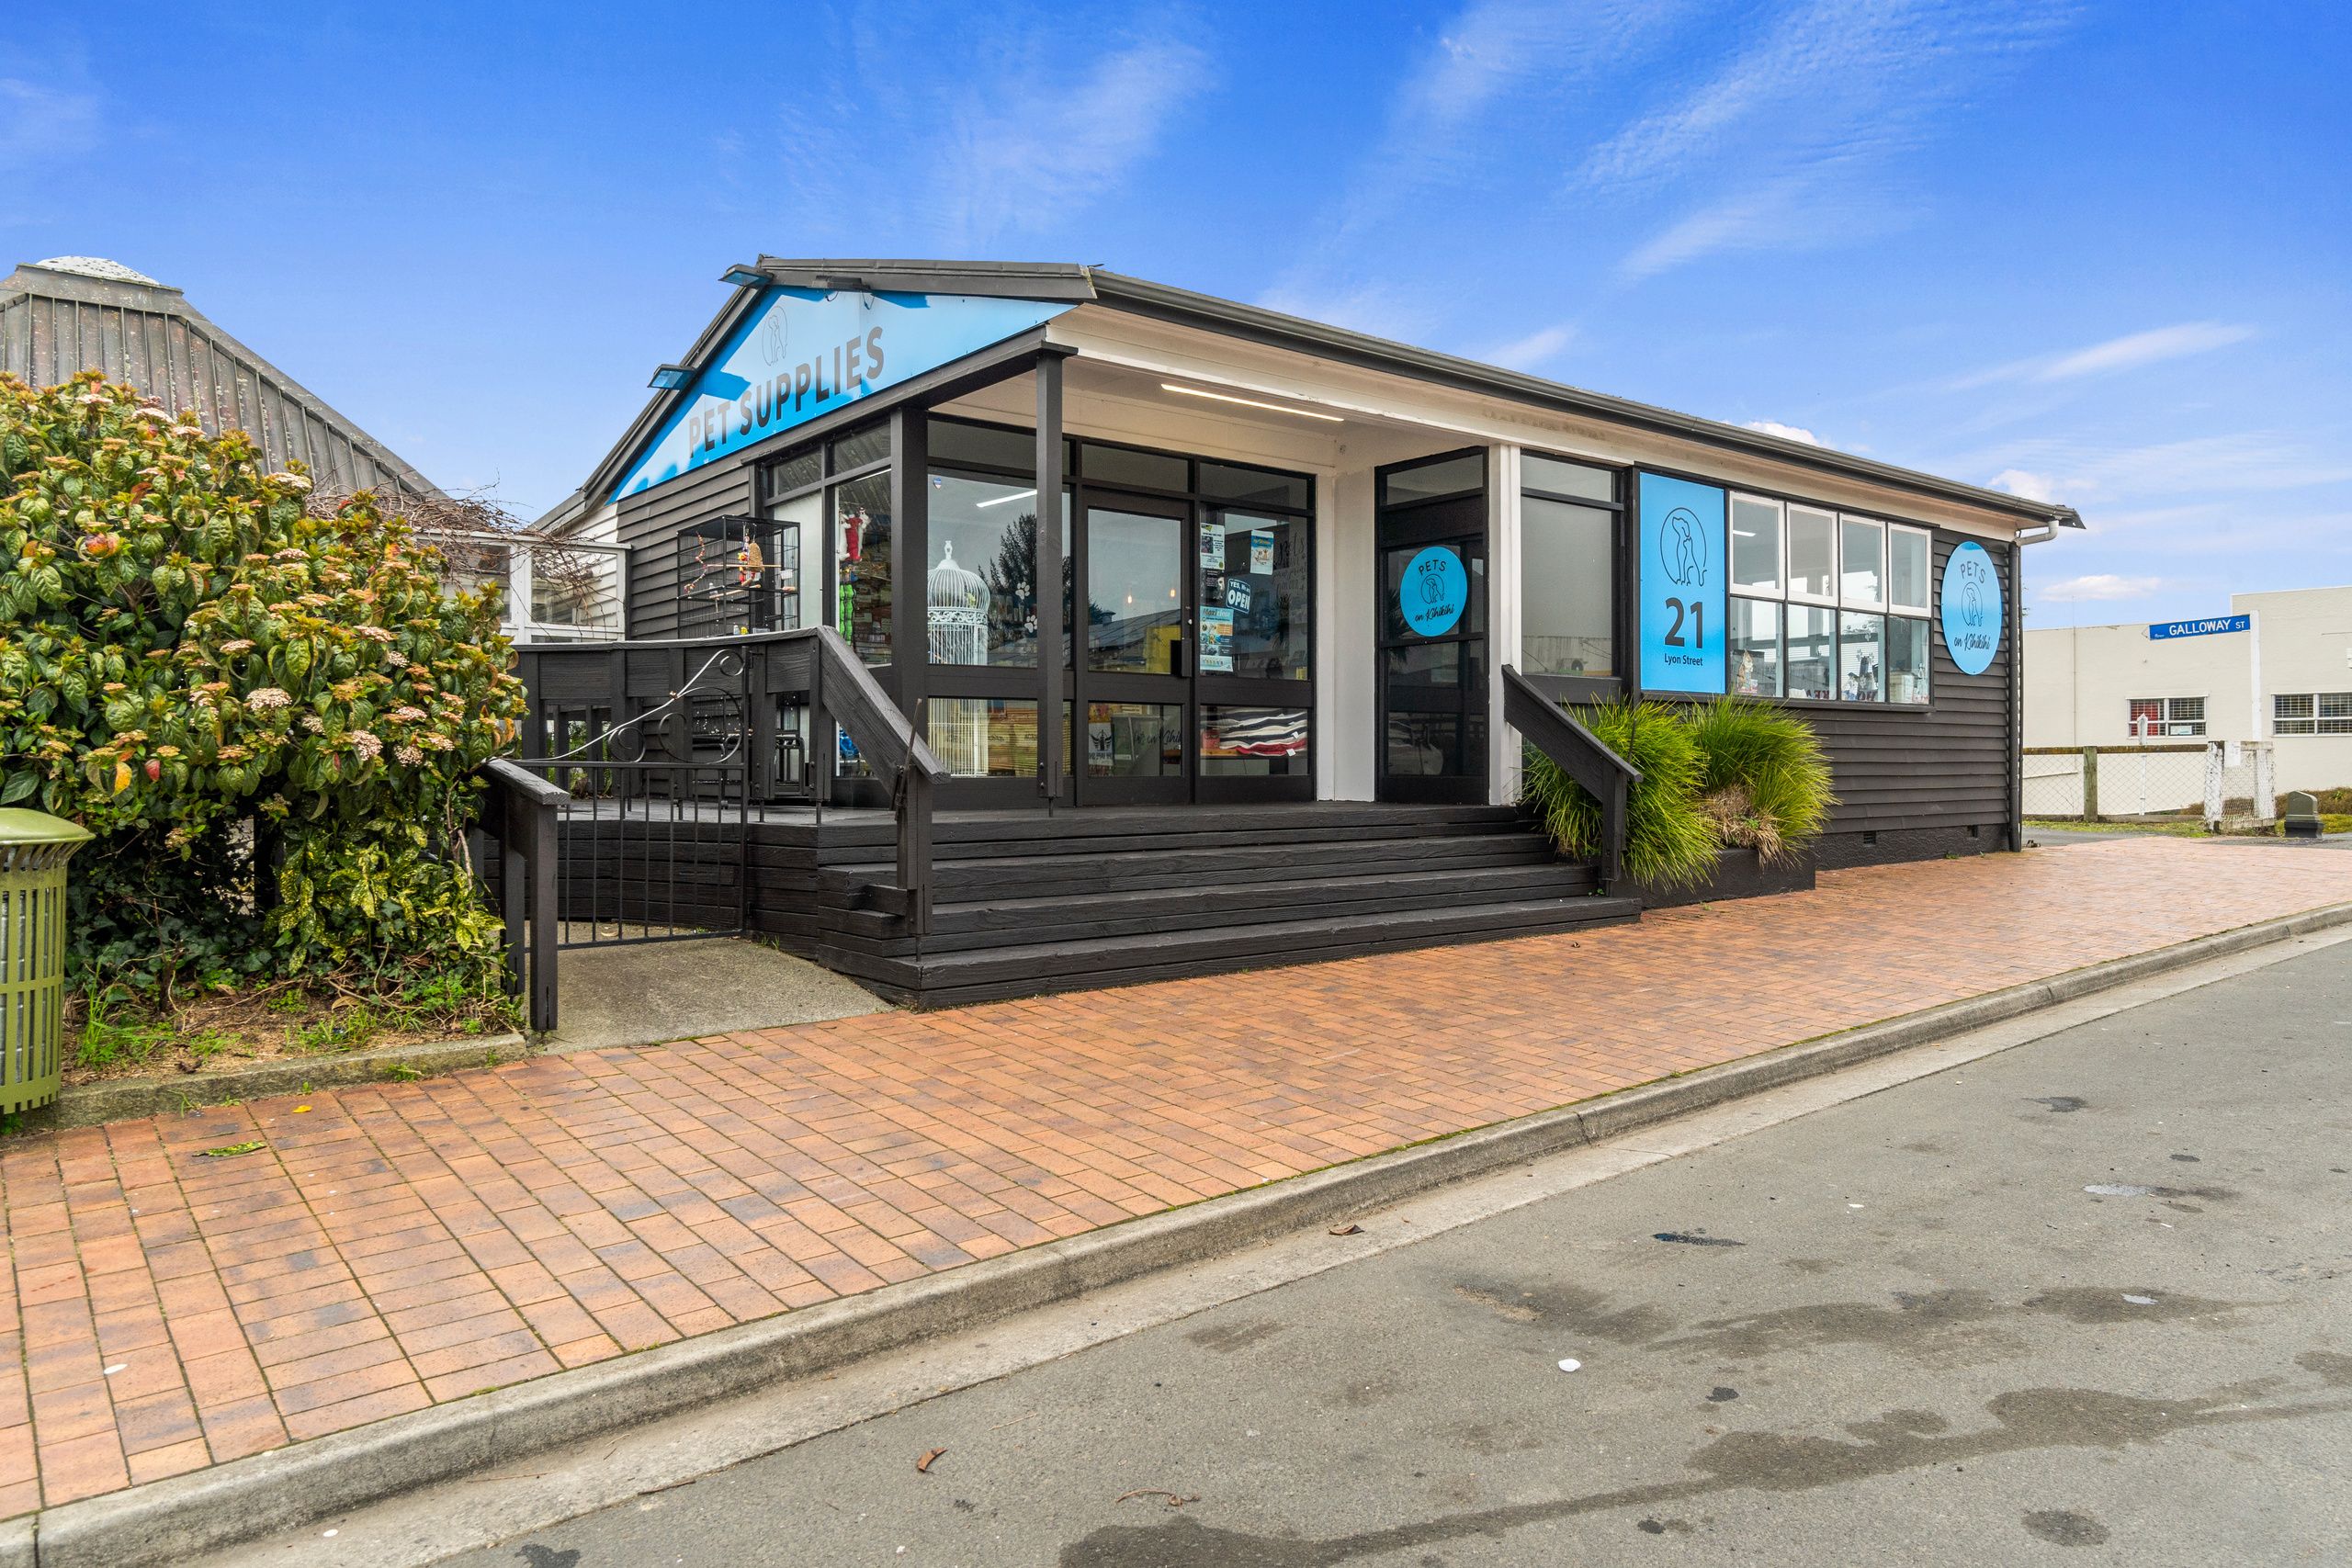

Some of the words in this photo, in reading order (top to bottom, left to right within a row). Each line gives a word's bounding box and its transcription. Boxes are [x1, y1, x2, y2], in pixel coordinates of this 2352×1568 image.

[689, 402, 730, 458] PET
[739, 326, 885, 436] SUPPLIES
[1418, 558, 1447, 576] PETS
[1960, 560, 1986, 584] PETS
[1230, 581, 1241, 591] YES,
[1227, 589, 1250, 610] OPEN
[1415, 614, 1424, 622] on
[1426, 604, 1455, 622] Kihikihi
[1664, 597, 1703, 649] 21
[2168, 619, 2232, 636] GALLOWAY
[2235, 621, 2245, 630] ST
[1954, 634, 1962, 648] on
[1964, 632, 1990, 652] Kihikihi
[1664, 653, 1681, 666] Lyon
[1682, 654, 1703, 667] Street
